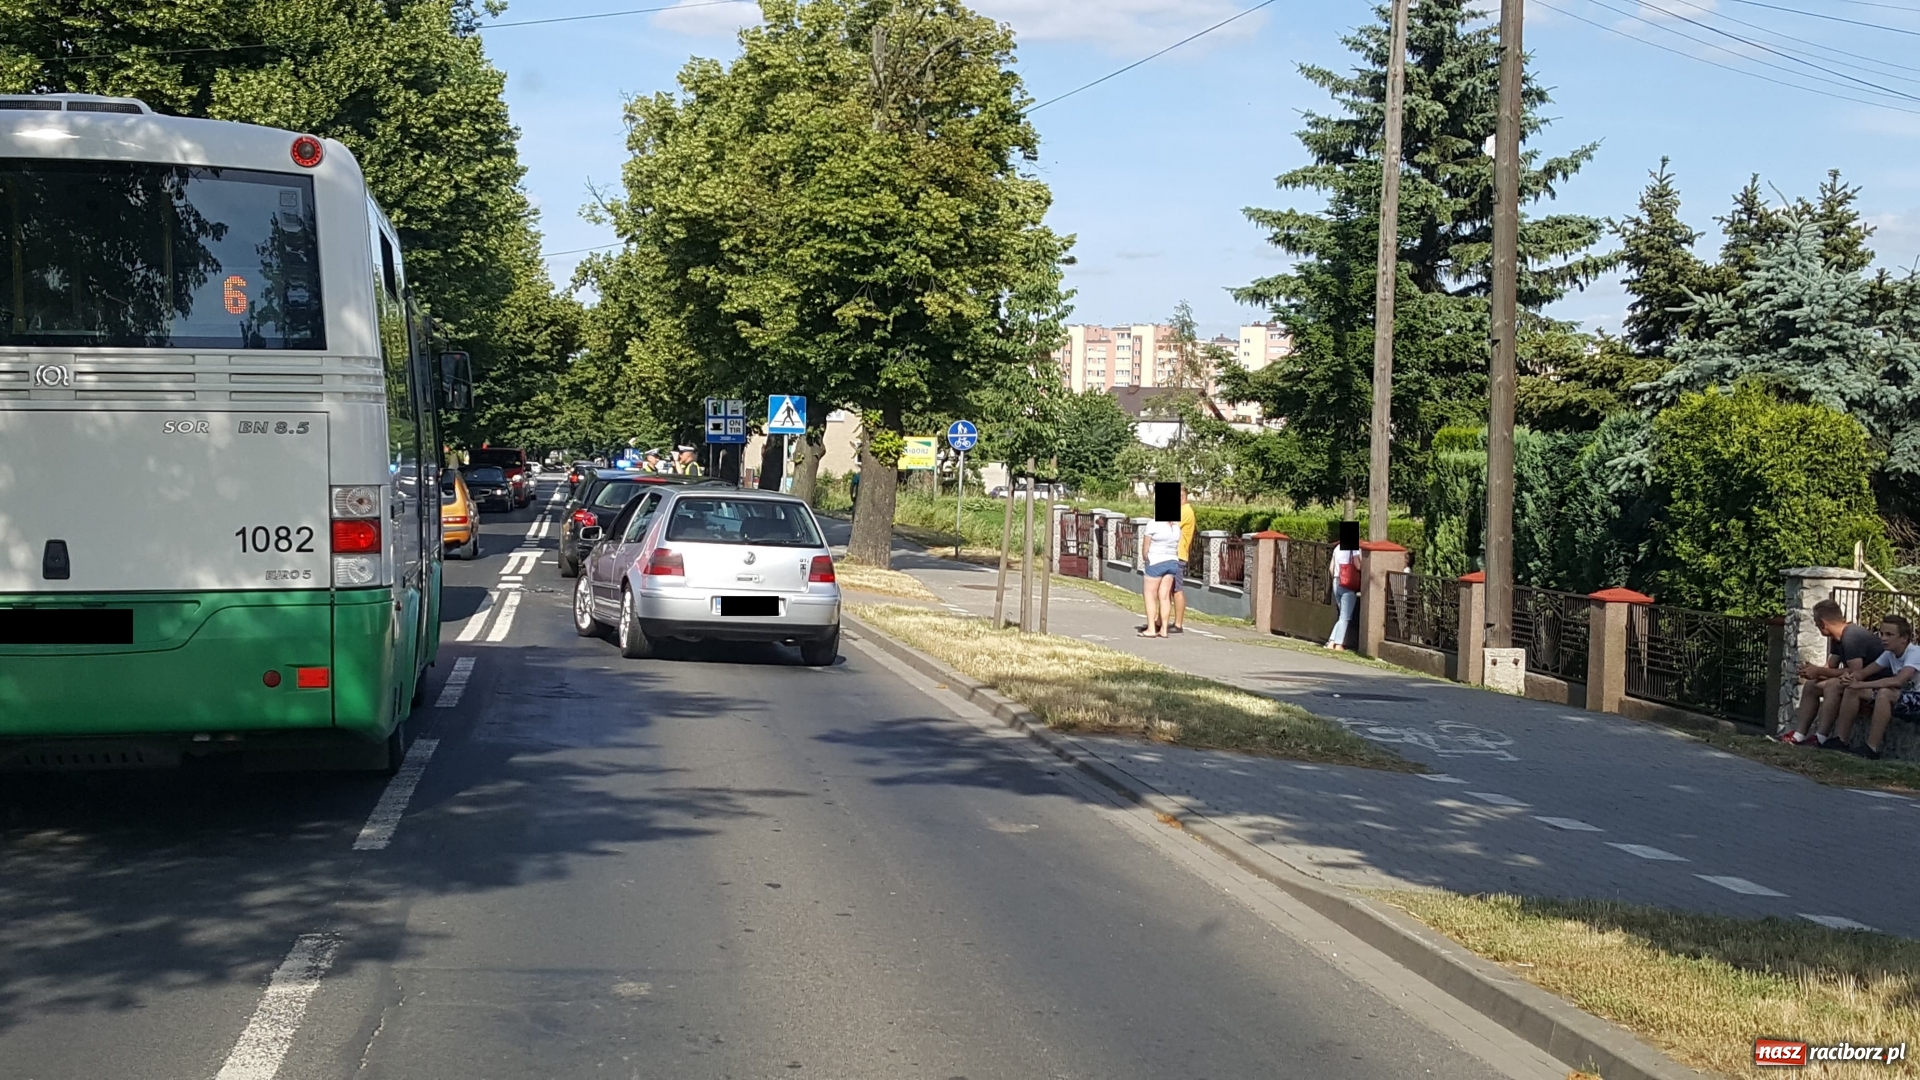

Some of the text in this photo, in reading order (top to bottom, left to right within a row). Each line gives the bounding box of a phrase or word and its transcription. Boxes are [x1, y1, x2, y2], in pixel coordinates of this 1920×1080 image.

[223, 275, 247, 315] 6
[163, 420, 310, 434] SOR BN 8.5
[235, 525, 314, 553] 1082
[265, 570, 312, 580] EURO 5
